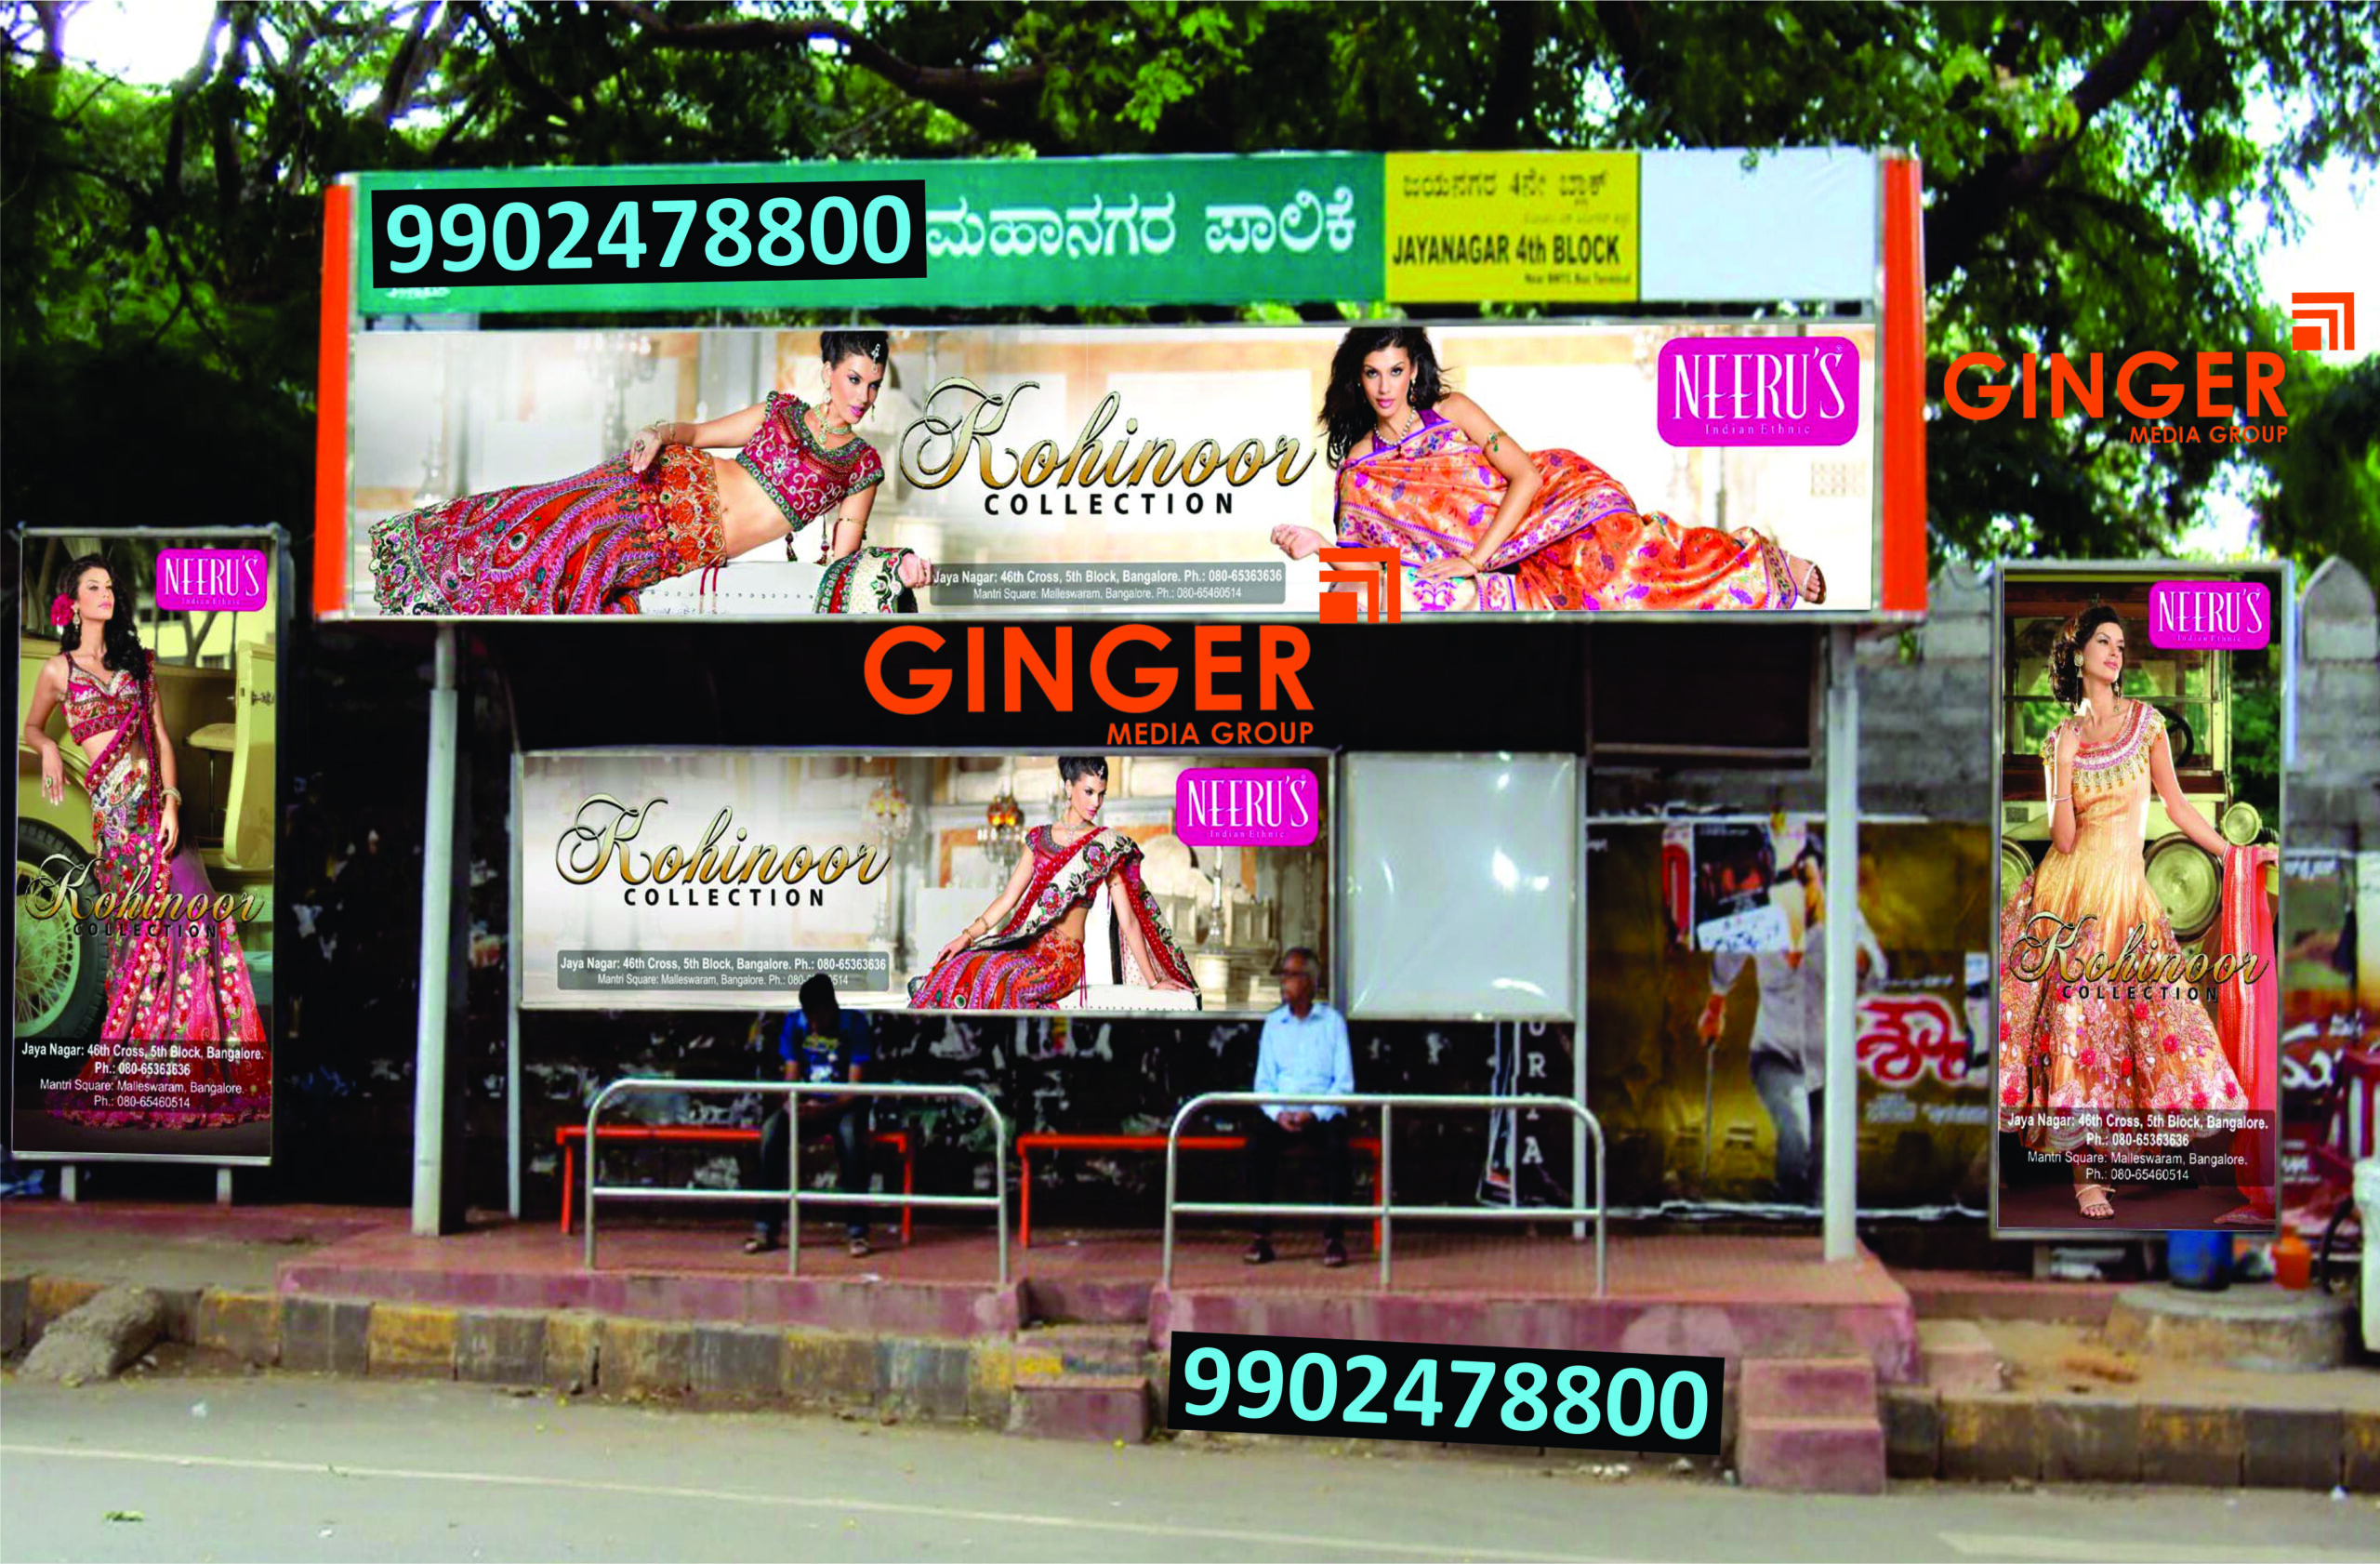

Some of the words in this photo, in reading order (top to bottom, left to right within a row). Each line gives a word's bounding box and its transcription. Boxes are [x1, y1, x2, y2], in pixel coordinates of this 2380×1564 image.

[927, 193, 1176, 258] ಮಹಾನಗರ
[1206, 186, 1356, 255] ಪಾಲಿಕೆ
[1393, 235, 1510, 265] JAYANAGAR
[1515, 235, 1546, 263] 4th
[1553, 235, 1620, 264] BLOCK
[1673, 346, 1845, 419] NEERU'S
[899, 377, 1317, 490] Kohinoor
[1705, 425, 1754, 434] Indian
[1761, 425, 1811, 434] Ethnic
[984, 493, 1233, 515] COLLECTION
[165, 555, 259, 596] NEERU'S
[933, 570, 959, 586] Jaya
[961, 570, 998, 586] Nagar:
[1000, 570, 1025, 583] 46th
[1026, 570, 1063, 585] Cross,
[1065, 570, 1082, 583] 5th
[1086, 570, 1119, 584] Block,
[1122, 569, 1182, 586] Bangalore.
[1184, 569, 1206, 582] Ph.:
[1209, 569, 1283, 582] 080-65363636
[973, 588, 1001, 600] Mantri
[1004, 588, 1038, 602] Square:
[1105, 588, 1154, 601] Bangalore.
[1157, 588, 1174, 599] Ph.:
[1177, 588, 1242, 599] 080-65460514
[2158, 589, 2262, 633] NEERU'S
[1186, 775, 1309, 827] NEERU'S
[555, 792, 891, 886] Kohinoor
[1210, 829, 1246, 838] Indian
[1250, 829, 1285, 838] Ethnic
[24, 853, 265, 922] Kohinoor
[624, 888, 824, 907] COLLECTION
[73, 923, 218, 938] COLLECTION
[2009, 910, 2269, 985] Kohinoor
[561, 957, 585, 972] Jaya
[587, 957, 620, 972] Nagar:
[623, 957, 645, 969] 46th
[648, 957, 681, 970] Cross,
[683, 958, 699, 970] 5th
[702, 958, 734, 971] Block,
[736, 958, 791, 972] Bangalore.
[794, 958, 814, 970] Ph.:
[817, 958, 886, 970] 080-65363636
[598, 974, 624, 984] Mantri
[626, 974, 658, 986] Square:
[661, 974, 719, 986] Malleswaram,
[721, 974, 766, 986] Bangalore.
[769, 974, 786, 985] Ph.:
[2062, 986, 2218, 1001] COLLECTION
[21, 1042, 46, 1058] Jaya
[49, 1043, 85, 1058] Nagar:
[87, 1044, 110, 1056] 46th
[112, 1044, 148, 1058] Cross,
[151, 1045, 166, 1057] 5th
[170, 1046, 203, 1059] Block,
[206, 1046, 264, 1062] Bangalore.
[95, 1062, 115, 1074] Ph.:
[118, 1062, 191, 1075] 080-65363636
[40, 1079, 72, 1090] Mantri
[74, 1080, 114, 1093] Square:
[190, 1081, 245, 1097] Bangalore.
[94, 1095, 113, 1107] Ph.:
[117, 1096, 190, 1108] 080-65460514
[2008, 1113, 2034, 1128] Jaya
[2037, 1113, 2075, 1129] Nagar:
[2078, 1114, 2103, 1126] 46th
[2106, 1114, 2144, 1129] Cross,
[2147, 1115, 2164, 1127] 5th
[2167, 1115, 2203, 1129] Block,
[2206, 1116, 2268, 1132] Bangalore.
[2086, 1133, 2109, 1146] Ph.:
[2111, 1133, 2189, 1146] 080-65363636
[2028, 1151, 2062, 1162] Mantri
[2065, 1151, 2108, 1165] Square:
[2110, 1152, 2186, 1165] Malleswaram,
[2188, 1153, 2248, 1168] Bangalore.
[2085, 1168, 2108, 1179] Ph.:
[2110, 1169, 2189, 1181] 080-65460514
